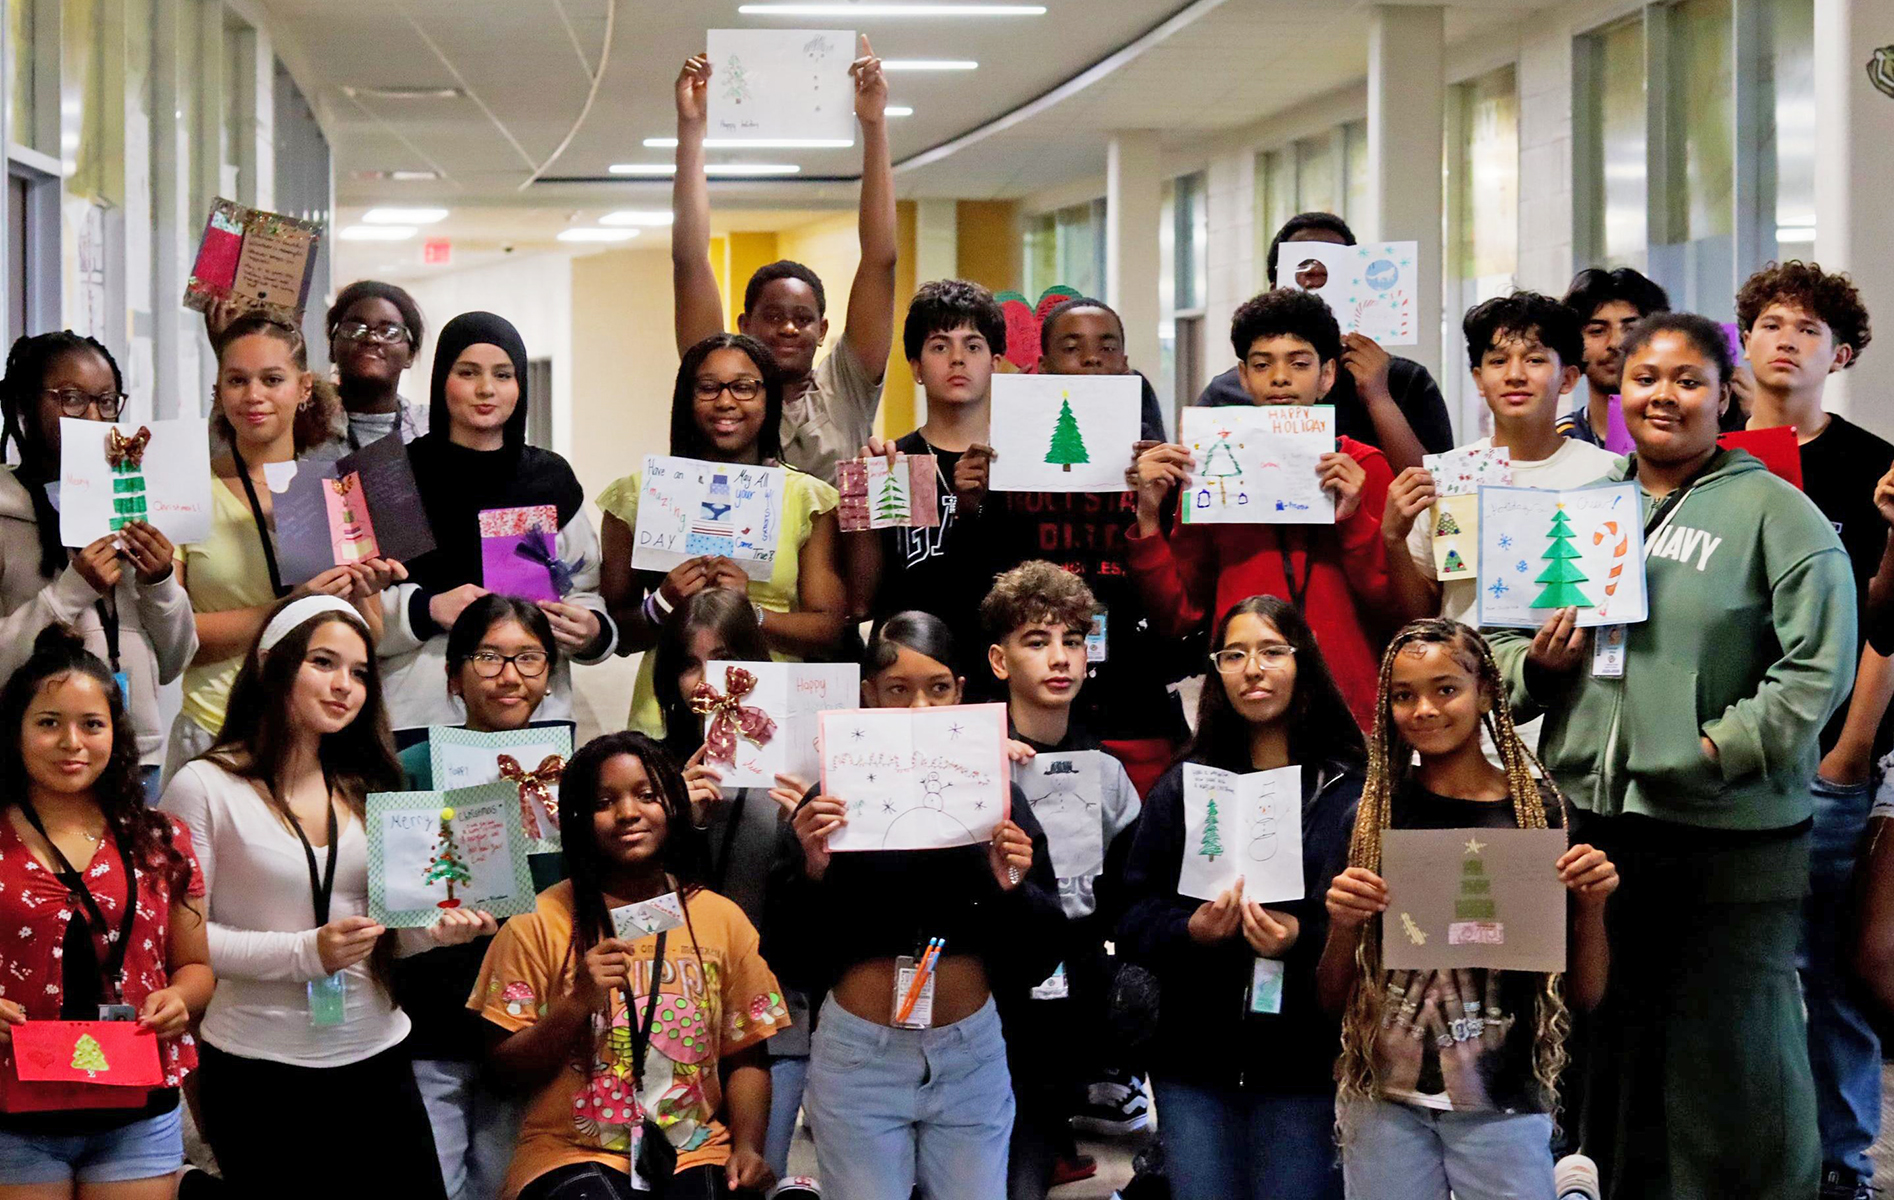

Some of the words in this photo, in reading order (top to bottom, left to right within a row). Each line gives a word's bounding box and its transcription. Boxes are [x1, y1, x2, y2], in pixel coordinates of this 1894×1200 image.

[1272, 420, 1326, 434] HOLIDAY
[647, 458, 665, 476] Have
[640, 530, 676, 550] DAY
[797, 676, 827, 698] Happy
